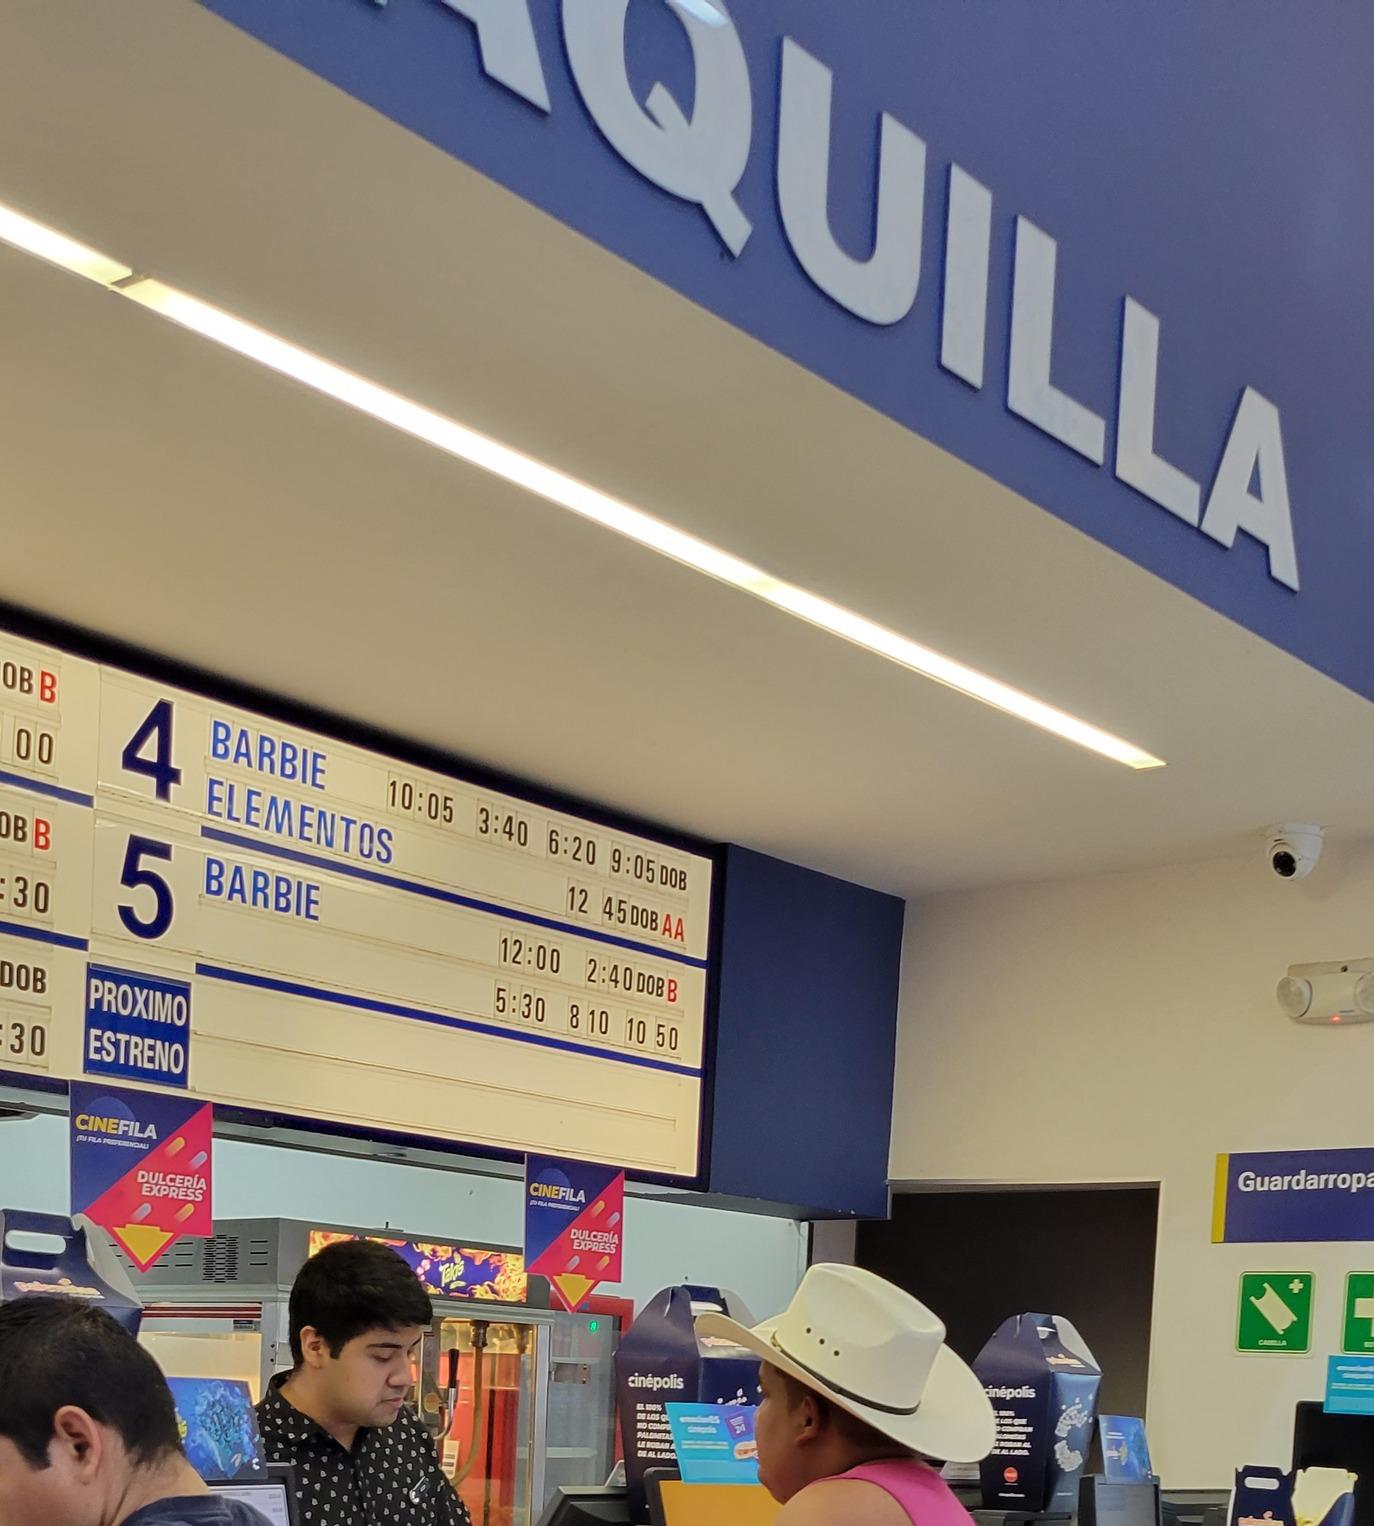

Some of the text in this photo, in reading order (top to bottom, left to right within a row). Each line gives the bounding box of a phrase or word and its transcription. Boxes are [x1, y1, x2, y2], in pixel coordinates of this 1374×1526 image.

[372, 0, 1300, 592] QUILLA
[2, 661, 57, 704] OB B
[121, 697, 183, 803] 4
[211, 719, 327, 790] BARBIE
[389, 779, 454, 823] 10:05
[478, 807, 528, 846] 3:40
[548, 829, 596, 865] 6:20
[611, 848, 655, 883] 9:05
[34, 817, 51, 851] B
[206, 777, 393, 864] ELEMENTOS
[568, 886, 589, 914] 12
[117, 833, 174, 939] 5
[204, 856, 320, 921] BARBIE
[500, 937, 561, 974] 12:00
[586, 958, 633, 991] 2:40
[0, 960, 46, 994] DOB
[88, 977, 188, 1027] PROXIMO
[495, 987, 546, 1022] 5:30
[87, 1027, 185, 1075] ESTRENO
[75, 1113, 158, 1140] CINEFILA
[136, 1170, 207, 1190] DULCERÍA
[141, 1184, 204, 1202] EXPRESS
[529, 1182, 586, 1203] CINEFILA
[570, 1228, 619, 1244] DULCERÍA
[572, 1239, 617, 1254] EXPRESS
[627, 1372, 685, 1391] cinépolis
